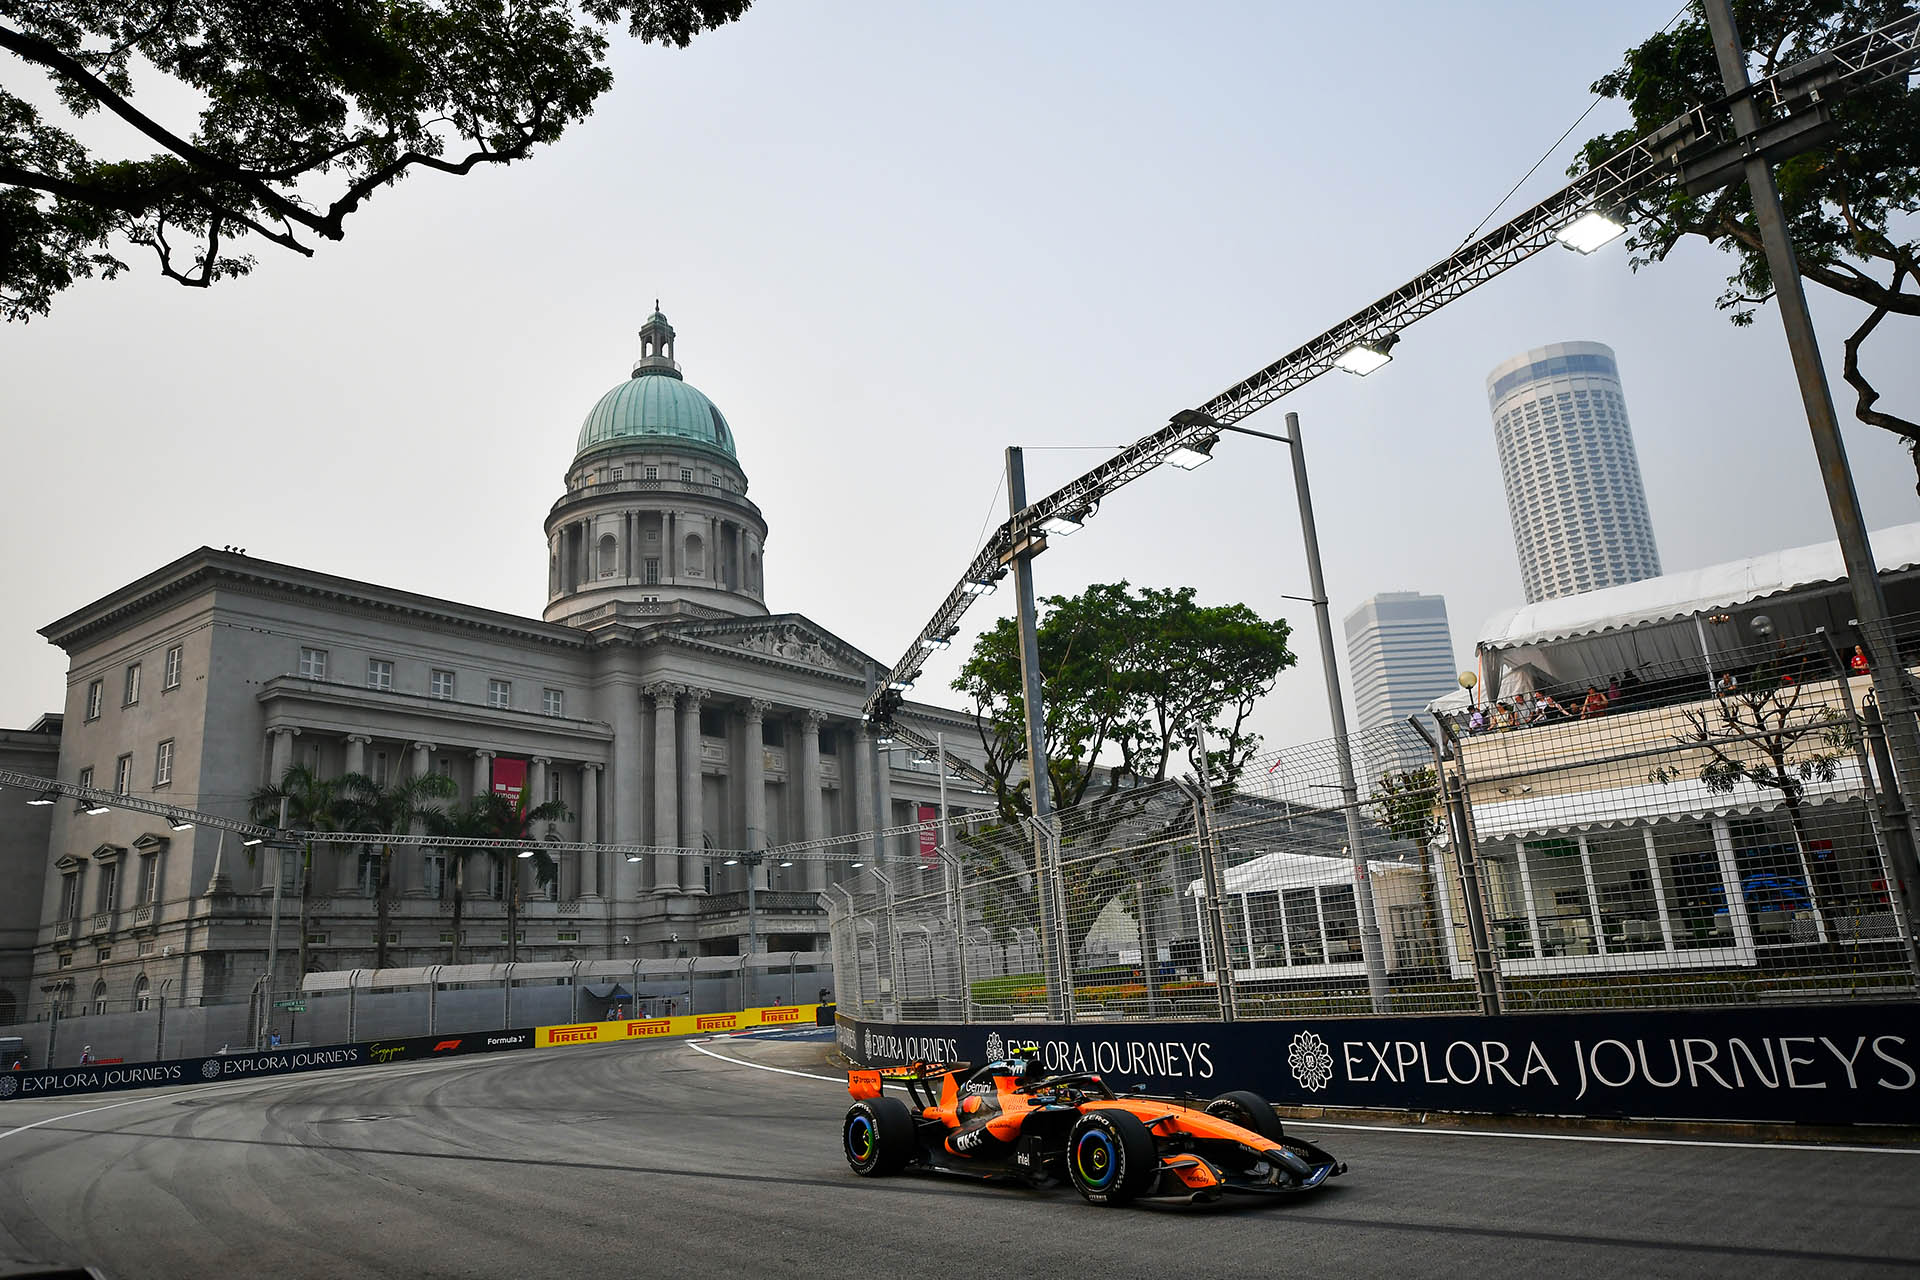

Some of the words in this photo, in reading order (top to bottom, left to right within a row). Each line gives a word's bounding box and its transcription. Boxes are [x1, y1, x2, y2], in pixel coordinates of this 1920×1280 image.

[697, 1015, 737, 1030] PIRELLI
[761, 1008, 799, 1022] PIRELLI
[549, 1026, 598, 1043] PIRELLI
[627, 1021, 671, 1036] PIRELLI
[487, 1037, 517, 1045] Formula
[872, 1034, 904, 1060] EXPLORA
[905, 1036, 958, 1065] JOURNEYS
[224, 1057, 288, 1073] EXPLORA
[291, 1048, 358, 1070] JOURNEYS
[1343, 1041, 1559, 1087] EXPLORA
[1574, 1035, 1916, 1101] JOURNEYS
[22, 1073, 99, 1091] EXPLORA
[102, 1065, 181, 1088] JOURNEYS
[965, 1080, 992, 1094] Gemini
[1017, 1151, 1030, 1167] intel
